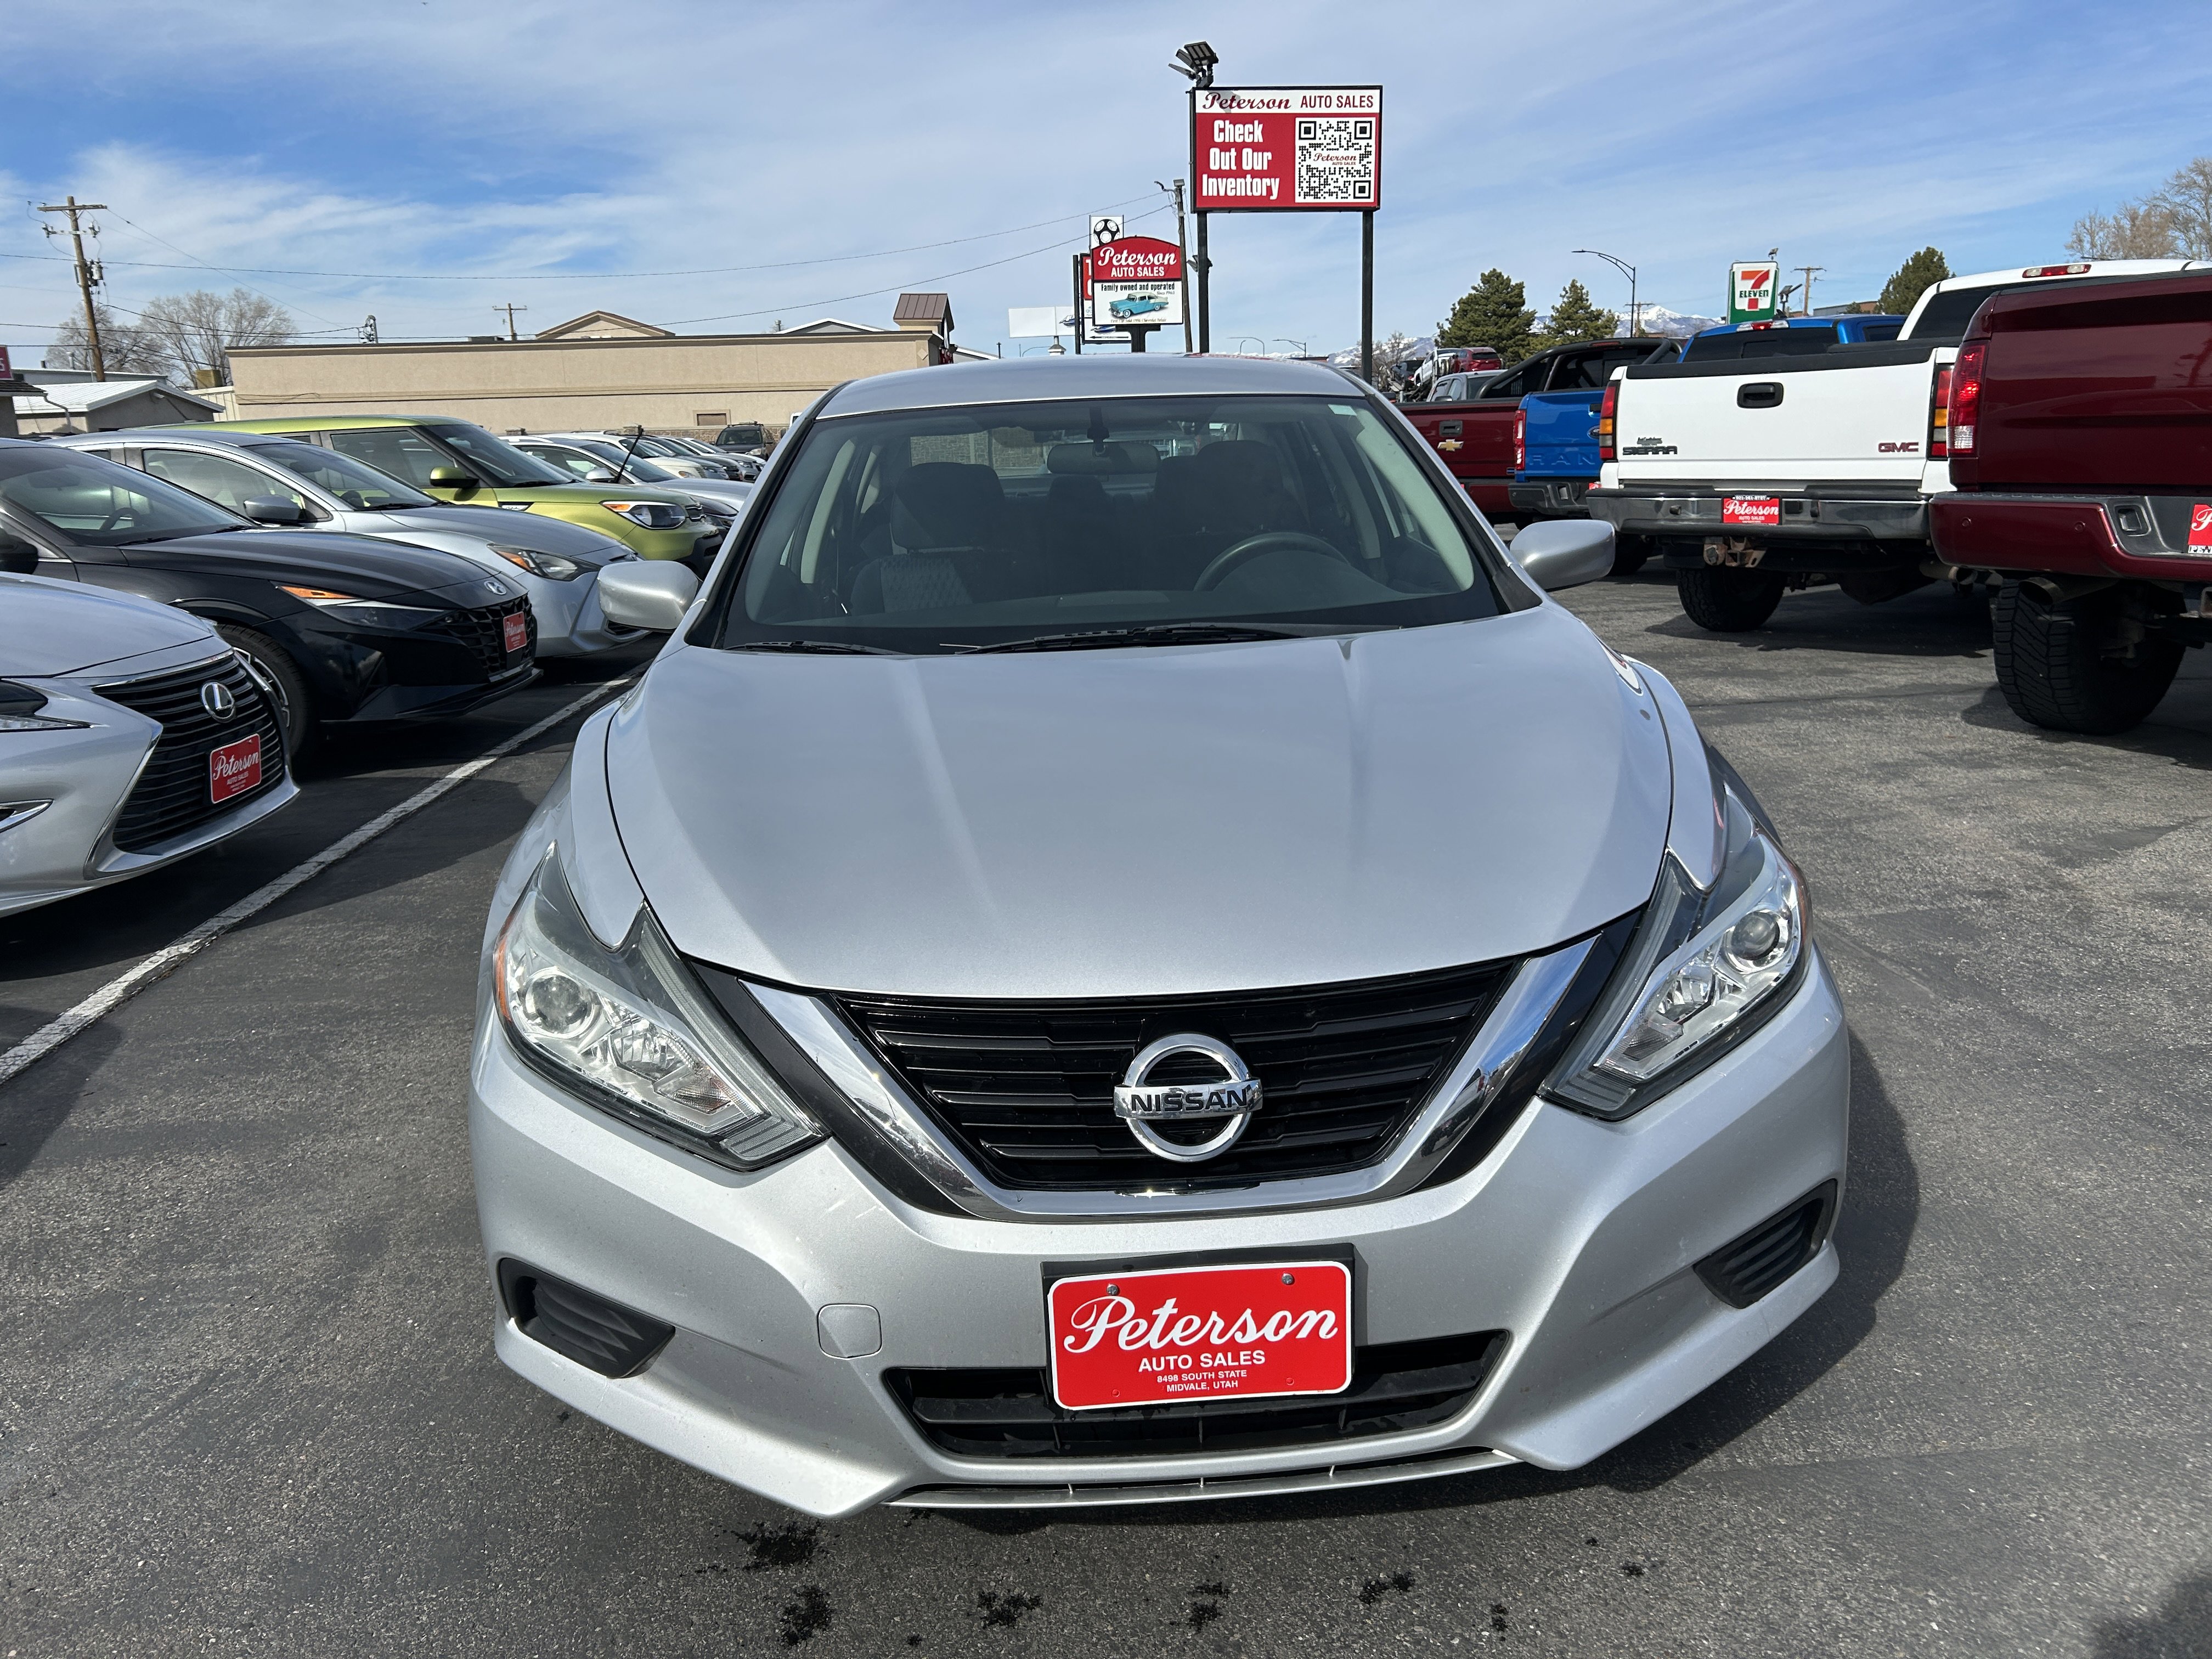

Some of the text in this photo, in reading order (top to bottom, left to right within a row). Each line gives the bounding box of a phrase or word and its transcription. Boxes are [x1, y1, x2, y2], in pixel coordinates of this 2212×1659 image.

[1202, 92, 1374, 110] Peterson AUTO SALES
[1214, 119, 1263, 143] Check
[1209, 147, 1272, 170] Out Our
[1313, 153, 1357, 161] Peterson
[1202, 173, 1280, 200] Inventory
[1097, 247, 1177, 266] Peterson
[1110, 266, 1165, 278] AUTO SALES
[1101, 284, 1118, 292] Family
[1150, 283, 1175, 291] operated
[1741, 269, 1770, 309] 7
[1622, 445, 1678, 455] SIERRA
[1878, 442, 1918, 452] GMC
[1529, 453, 1595, 466] RAN
[1723, 500, 1779, 515] Peterson
[212, 752, 259, 780] Peterson
[1131, 1087, 1248, 1112] NISSAN
[1064, 1295, 1338, 1353] Peterson
[1138, 1350, 1266, 1373] AUTO SALES
[1156, 1369, 1247, 1383] 8498 SOUTH STATE
[1166, 1380, 1238, 1392] MIDVALE, UTAH
